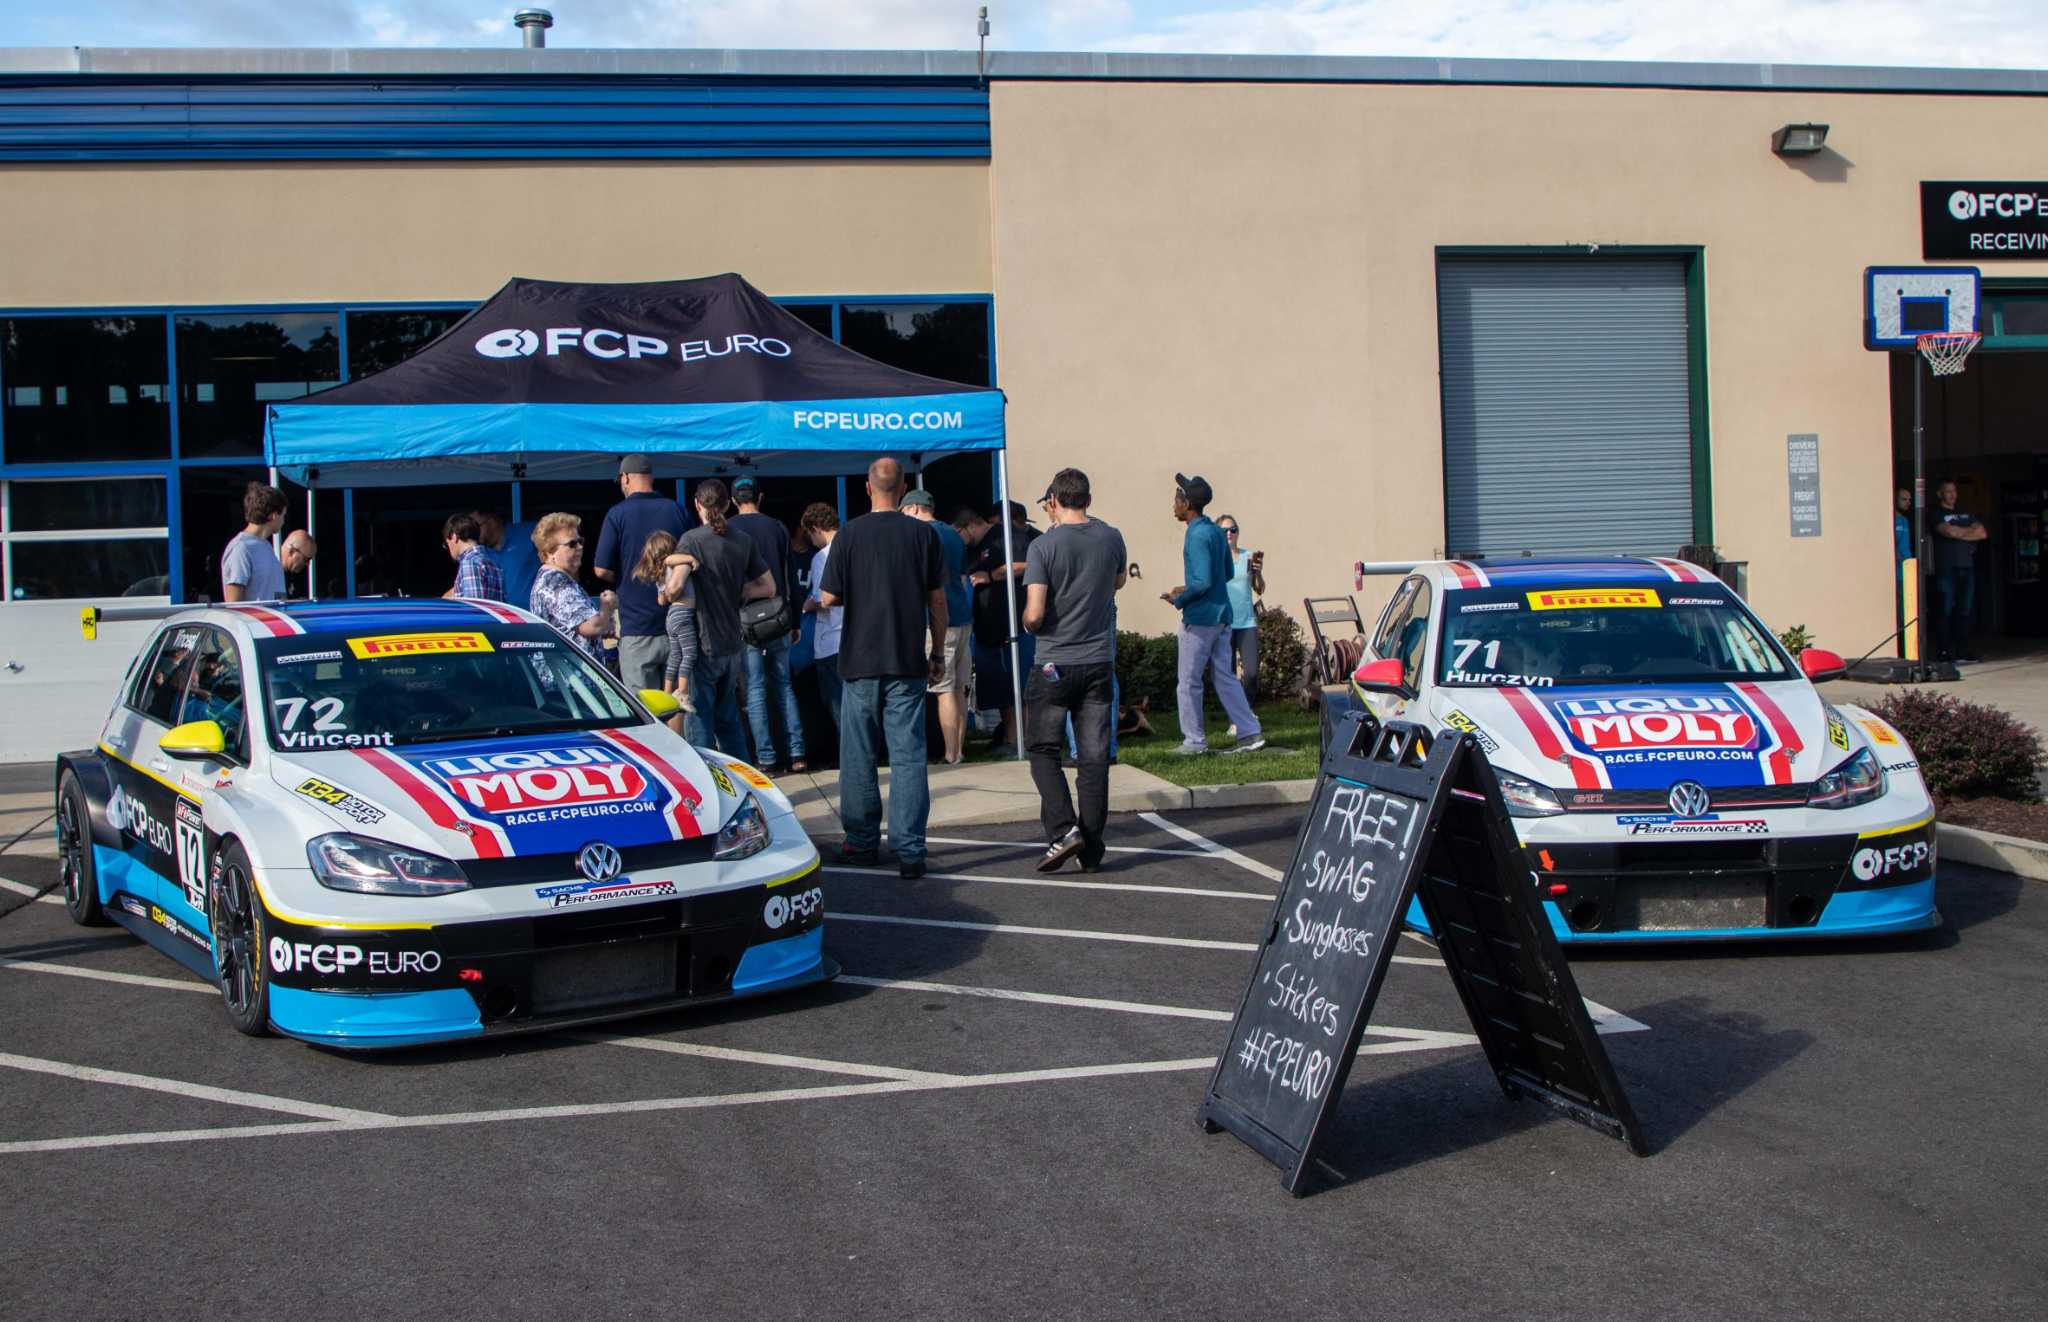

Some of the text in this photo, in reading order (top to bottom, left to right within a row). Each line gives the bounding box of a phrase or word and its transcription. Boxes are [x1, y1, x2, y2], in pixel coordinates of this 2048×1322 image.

[1979, 193, 2034, 217] FCP
[546, 328, 792, 361] FCP EURO
[793, 411, 962, 429] FCPEURO.COM
[1540, 591, 1647, 605] PIRELLI
[363, 636, 480, 654] PIRELLI
[1453, 639, 1501, 670] 71
[275, 697, 347, 731] 72
[1567, 698, 1733, 715] LIQUI
[279, 732, 394, 747] Vincent
[1576, 714, 1745, 745] MOLY
[437, 749, 612, 776] LIQUI
[1605, 751, 1754, 764] RACE.FCPEURO.COM
[296, 778, 348, 804] 034
[458, 764, 629, 807] MOLY
[344, 796, 386, 819] MOTOR
[506, 802, 656, 826] RACE.FCPEURO.COM
[1632, 815, 1667, 823] SACHS
[126, 796, 173, 855] FCP EURO
[1323, 786, 1420, 861] FREE!
[1631, 822, 1744, 835] PERFORMANCE
[1884, 841, 1929, 874] FCP
[1305, 850, 1376, 902] SWAG
[554, 887, 655, 906] PERFORMANCE
[789, 887, 823, 921] FCP
[1288, 898, 1374, 960] Sunglasses
[295, 943, 441, 974] FCP EURO
[1268, 963, 1340, 1036] Stickers
[1239, 1027, 1331, 1101] #FCPEURO
